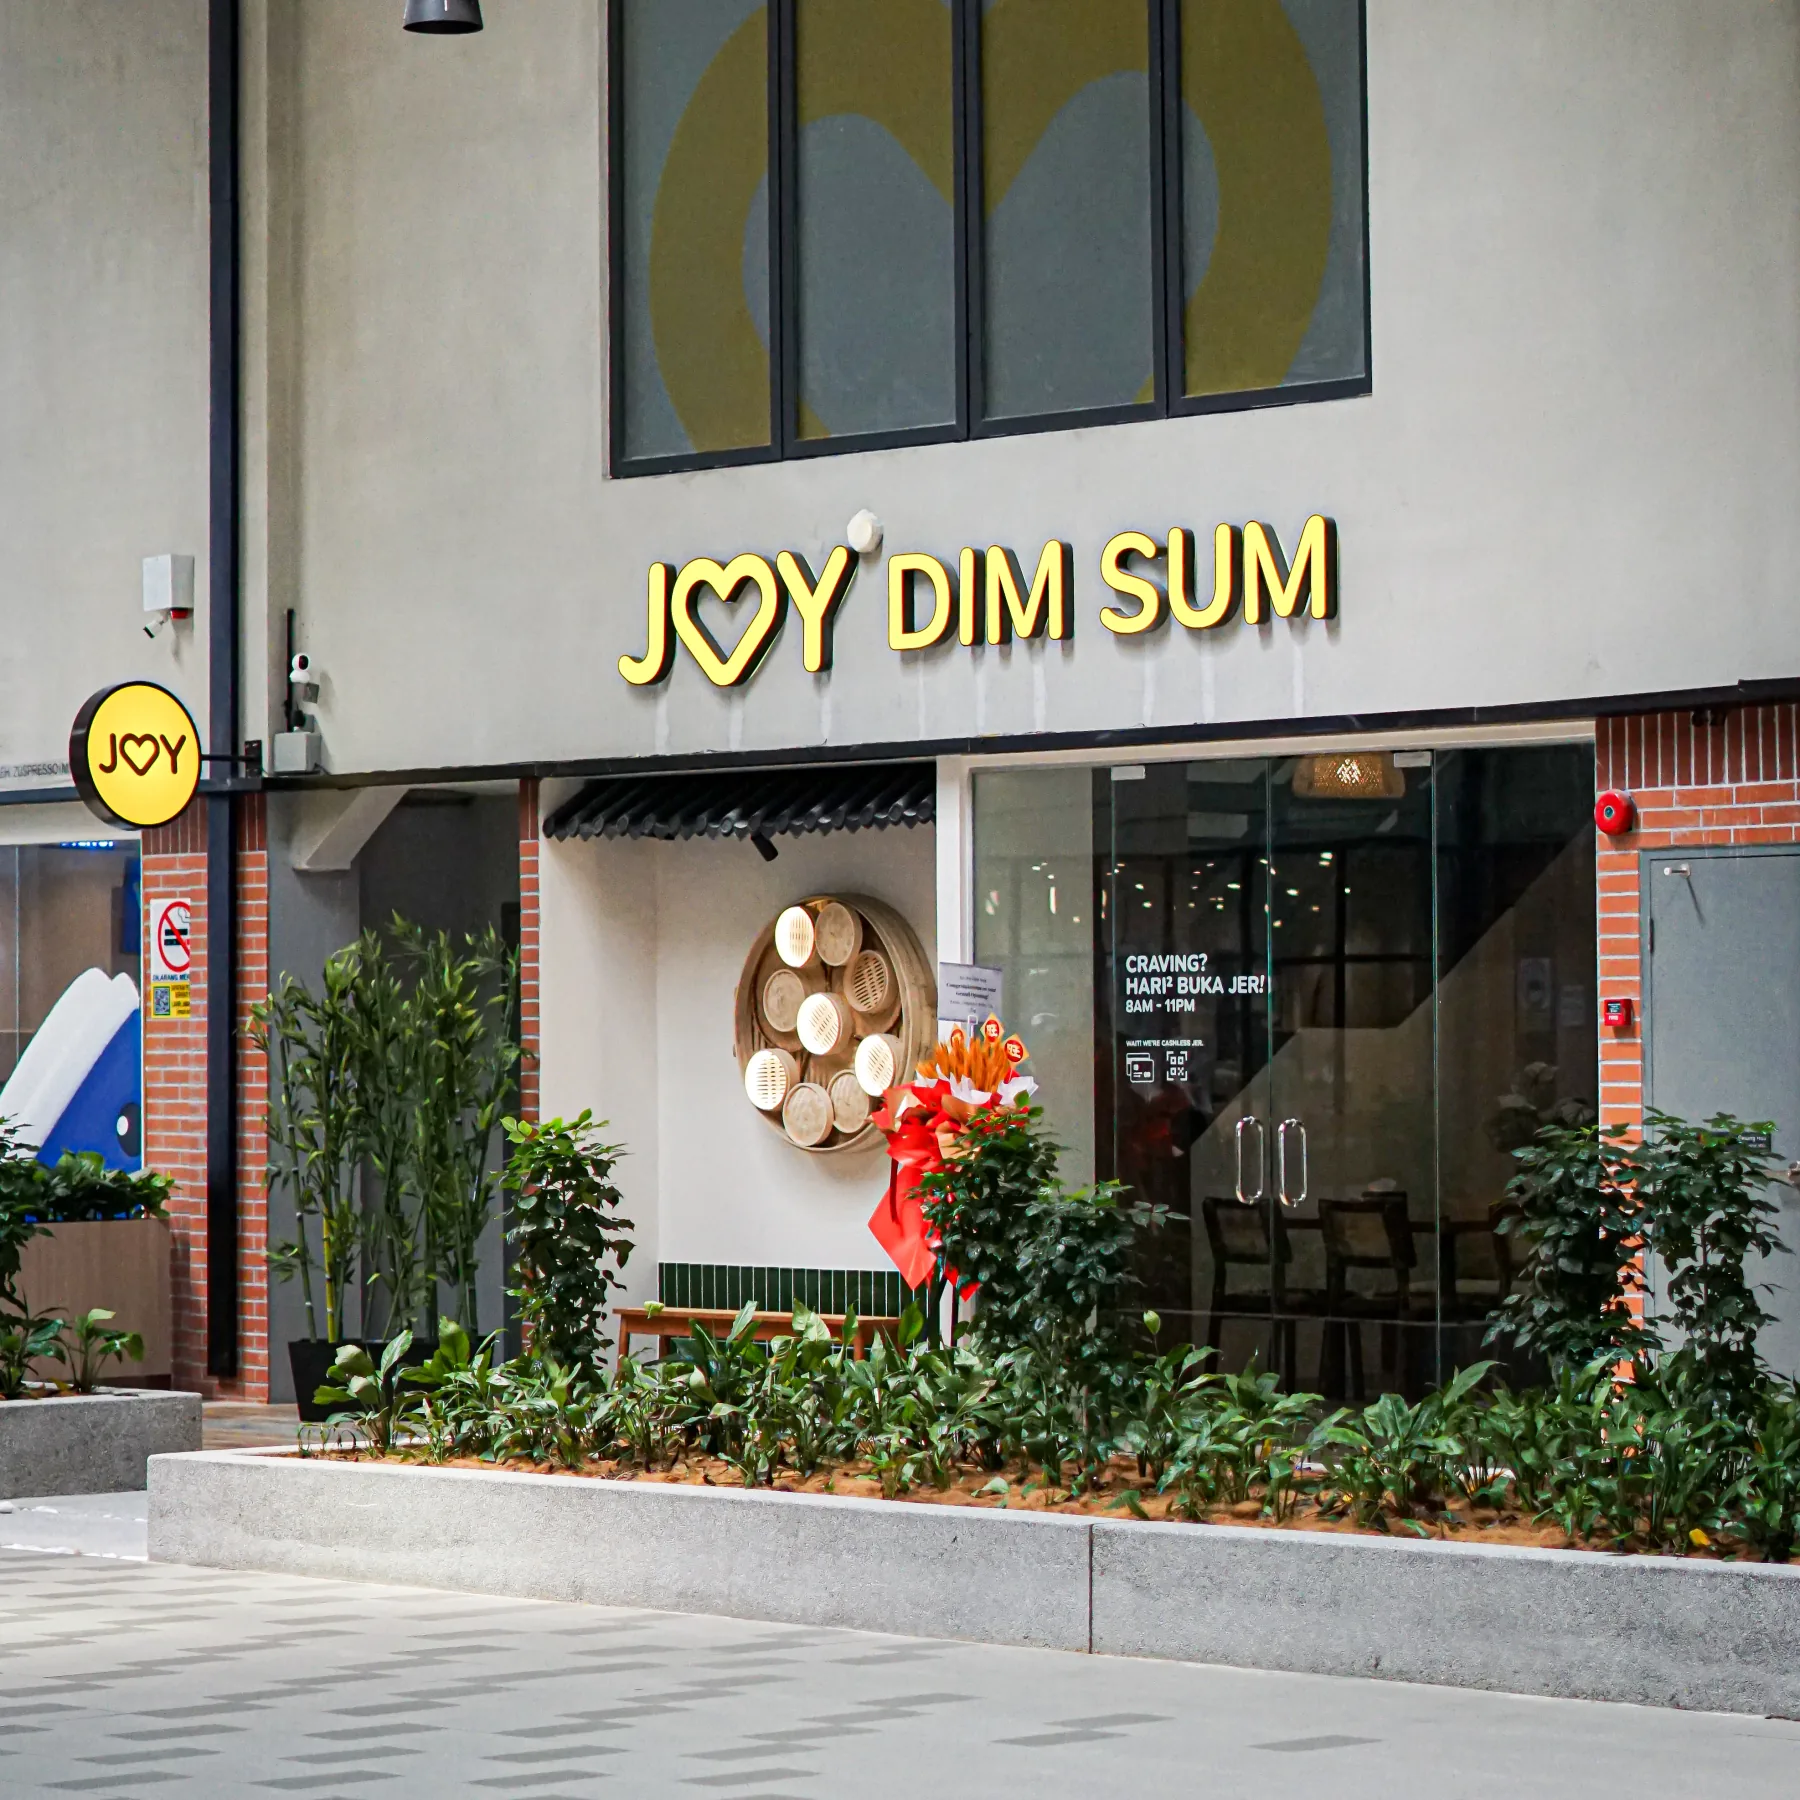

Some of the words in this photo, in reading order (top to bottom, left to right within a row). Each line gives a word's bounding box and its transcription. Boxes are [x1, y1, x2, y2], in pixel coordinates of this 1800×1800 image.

[888, 539, 1074, 652] DIM
[1100, 514, 1340, 635] SUM
[1125, 953, 1208, 973] CRAVING?
[1177, 976, 1224, 994] BUKA
[1228, 974, 1265, 994] JER!
[1125, 999, 1153, 1013] 8AM
[1164, 998, 1195, 1013] 11PM
[1161, 1039, 1191, 1047] CASHLESS
